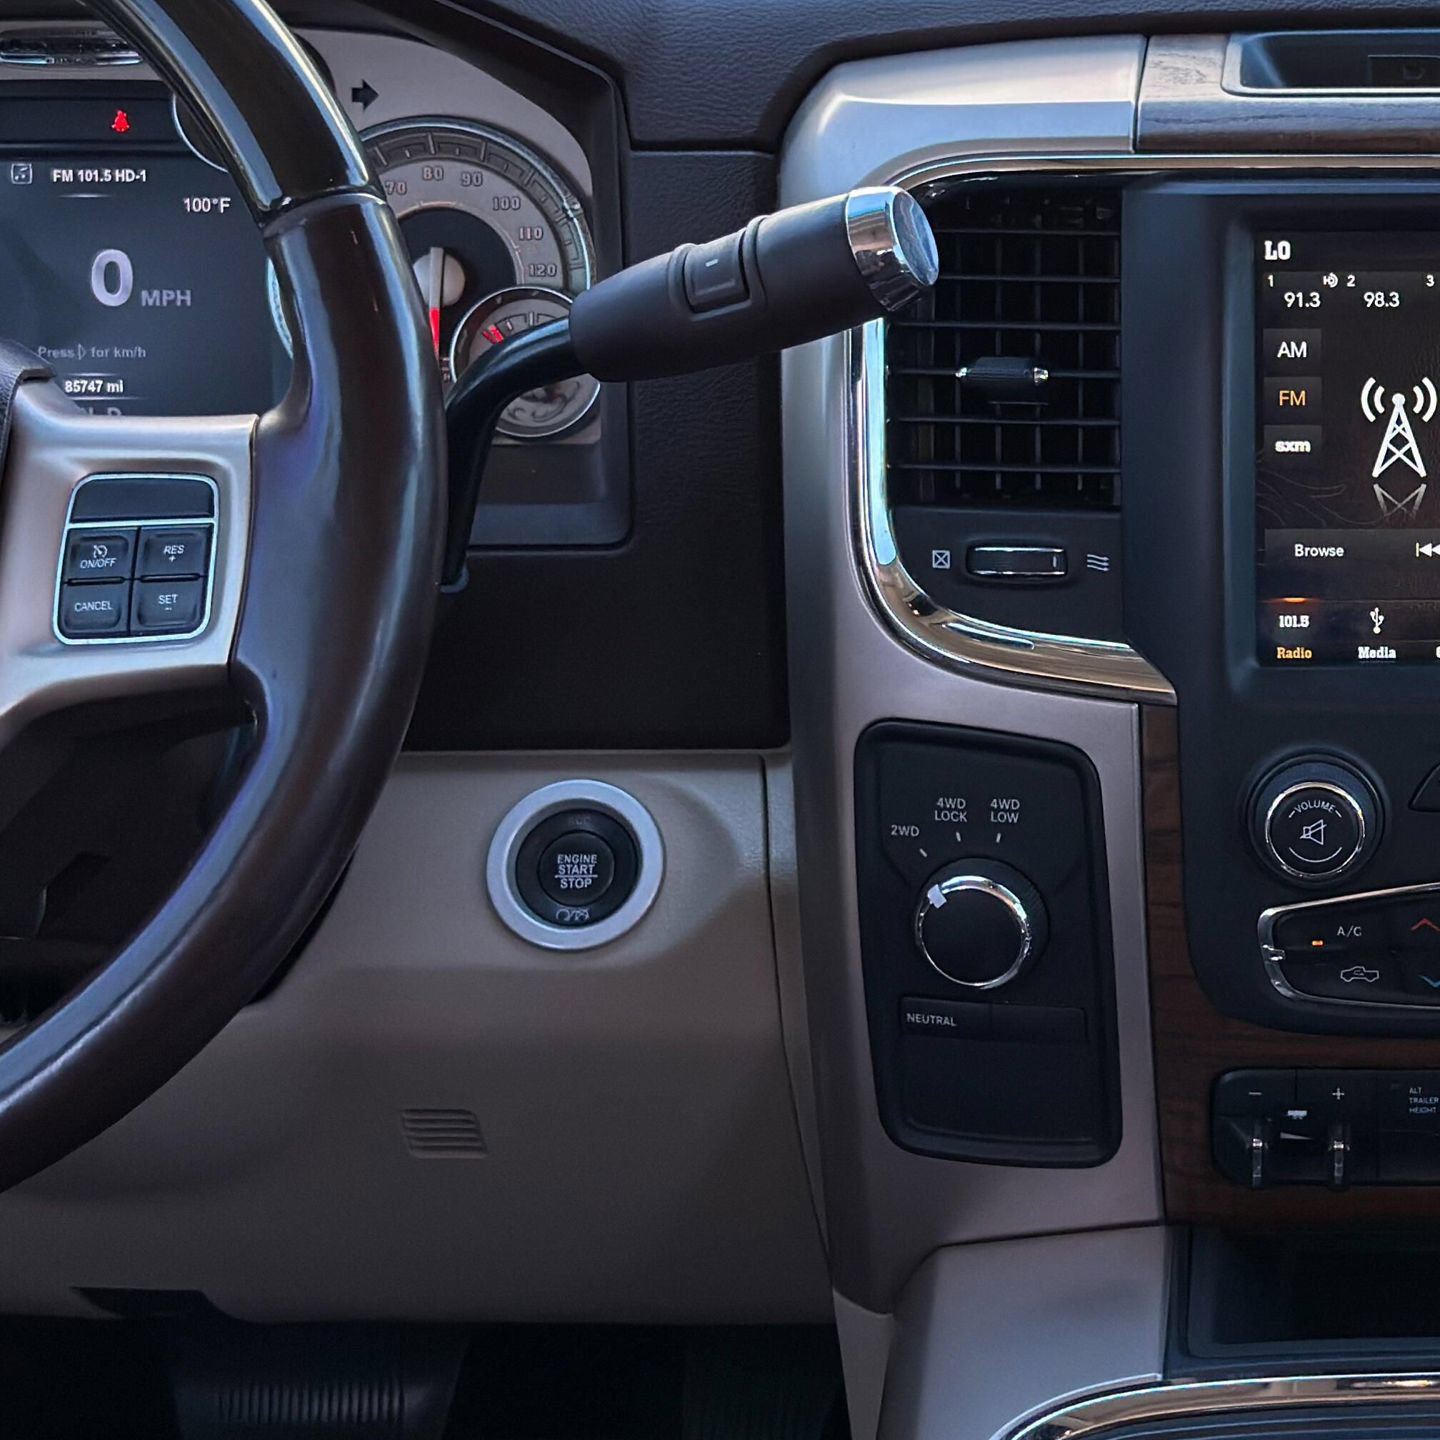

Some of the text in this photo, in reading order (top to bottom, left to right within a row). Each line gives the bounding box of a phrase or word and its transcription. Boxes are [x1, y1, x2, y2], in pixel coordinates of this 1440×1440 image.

[53, 169, 148, 183] FM 101.5 HD-1
[423, 166, 445, 182] 80
[461, 172, 484, 188] 90
[385, 180, 408, 196] 70
[183, 197, 232, 214] 100°F
[492, 197, 522, 211] 100
[518, 227, 544, 241] 110
[1264, 240, 1292, 261] LO
[528, 263, 559, 278] 120
[90, 248, 193, 308] 0 MPH
[1267, 274, 1275, 288] 1
[1346, 274, 1356, 288] 2
[1426, 274, 1436, 288] 3
[1283, 291, 1322, 309] 91.3
[1363, 291, 1401, 309] 98.3
[37, 346, 148, 360] Press for km/h
[1276, 340, 1308, 359] AM
[64, 379, 125, 394] 85747 mi
[1278, 389, 1307, 408] FM
[1274, 438, 1312, 454] sxm
[163, 544, 186, 556] RES
[1294, 542, 1345, 558] Browse
[79, 556, 118, 570] ON/OFF
[74, 599, 113, 613] CANCEL
[158, 593, 179, 605] SET
[1278, 614, 1310, 629] 101.5
[1276, 646, 1313, 660] Radio
[1357, 646, 1397, 660] Media
[936, 797, 967, 810] 4WD
[990, 798, 1021, 811] 4WD
[1294, 799, 1337, 814] VOLUME
[934, 810, 968, 823] LOCK
[990, 811, 1020, 824] LOW
[890, 824, 920, 837] 2WD
[557, 853, 598, 864] ENGINE
[558, 864, 596, 875] START
[560, 878, 592, 889] STOP
[1336, 925, 1362, 939] A/C
[906, 1012, 957, 1027] NEUTRAL
[1409, 1087, 1423, 1095] ALT
[1409, 1096, 1440, 1105] TRAILER
